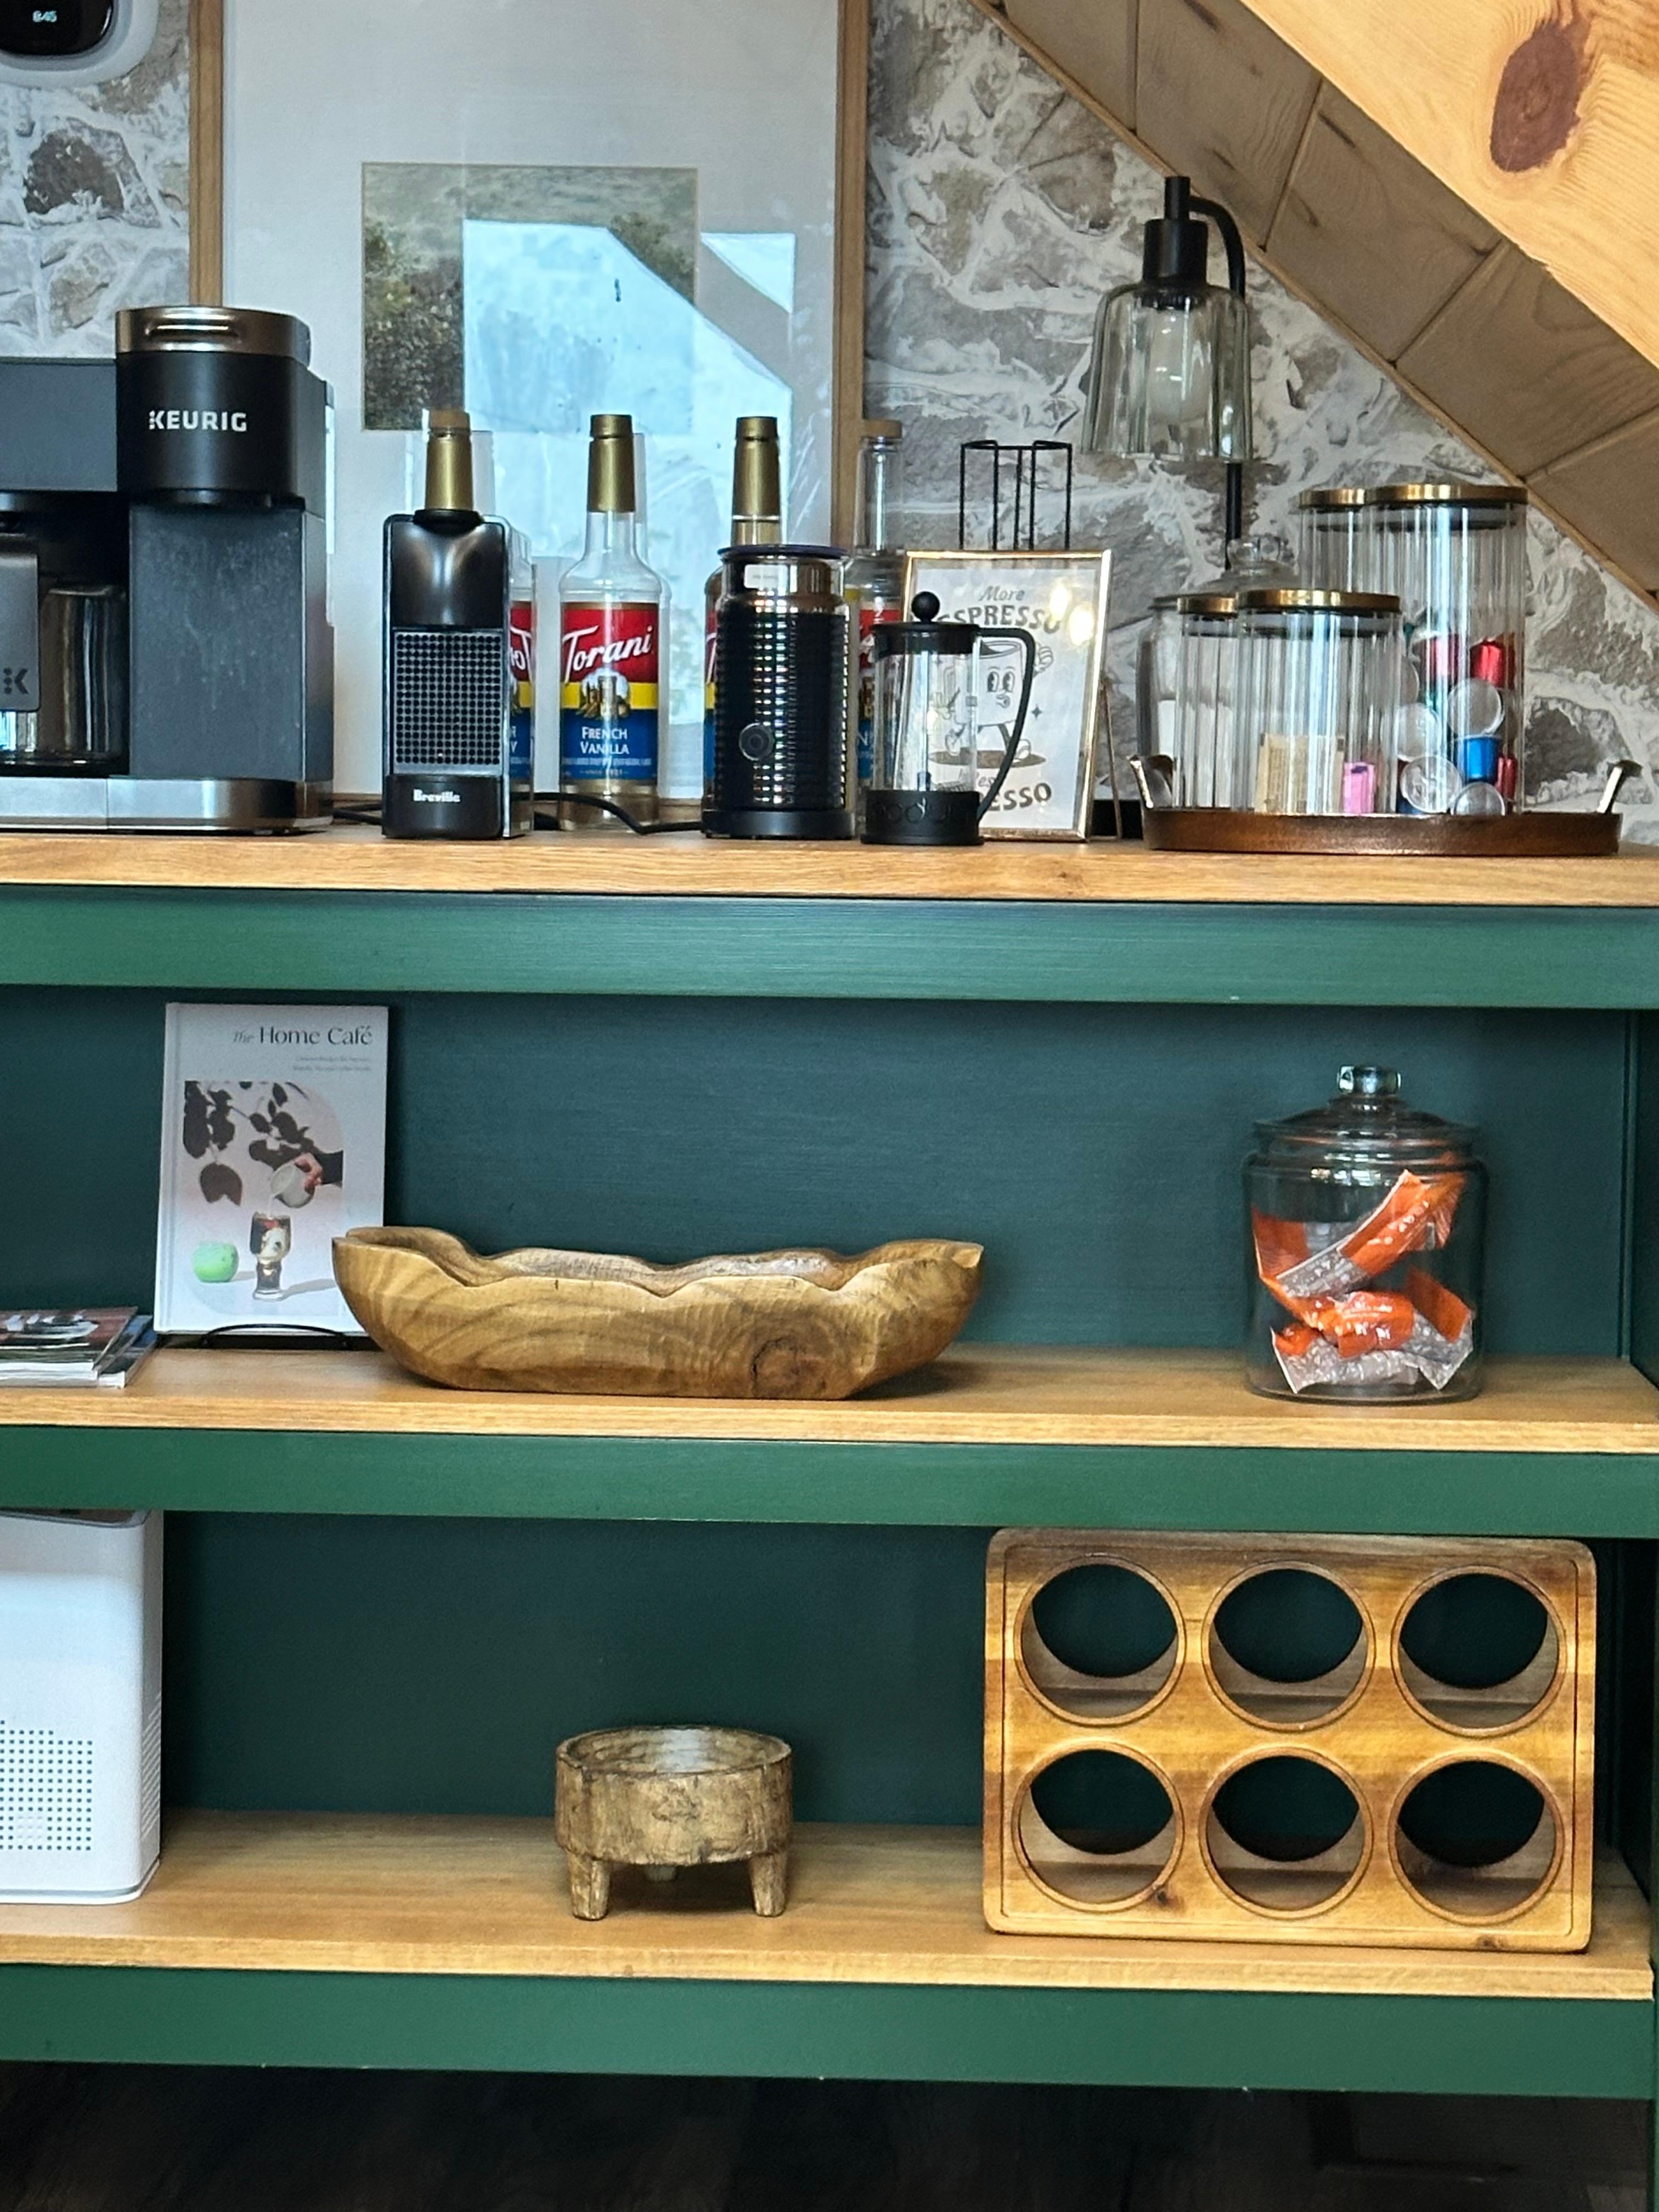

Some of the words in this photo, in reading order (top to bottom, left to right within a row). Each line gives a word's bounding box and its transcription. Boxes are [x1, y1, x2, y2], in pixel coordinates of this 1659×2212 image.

[149, 410, 247, 432] KEURIG
[978, 585, 1025, 602] More
[562, 625, 653, 685] Torani
[582, 726, 628, 740] FRENCH
[579, 741, 630, 754] VANILLA
[413, 789, 461, 802] Breville
[259, 1026, 320, 1045] Home
[328, 1025, 373, 1045] Café
